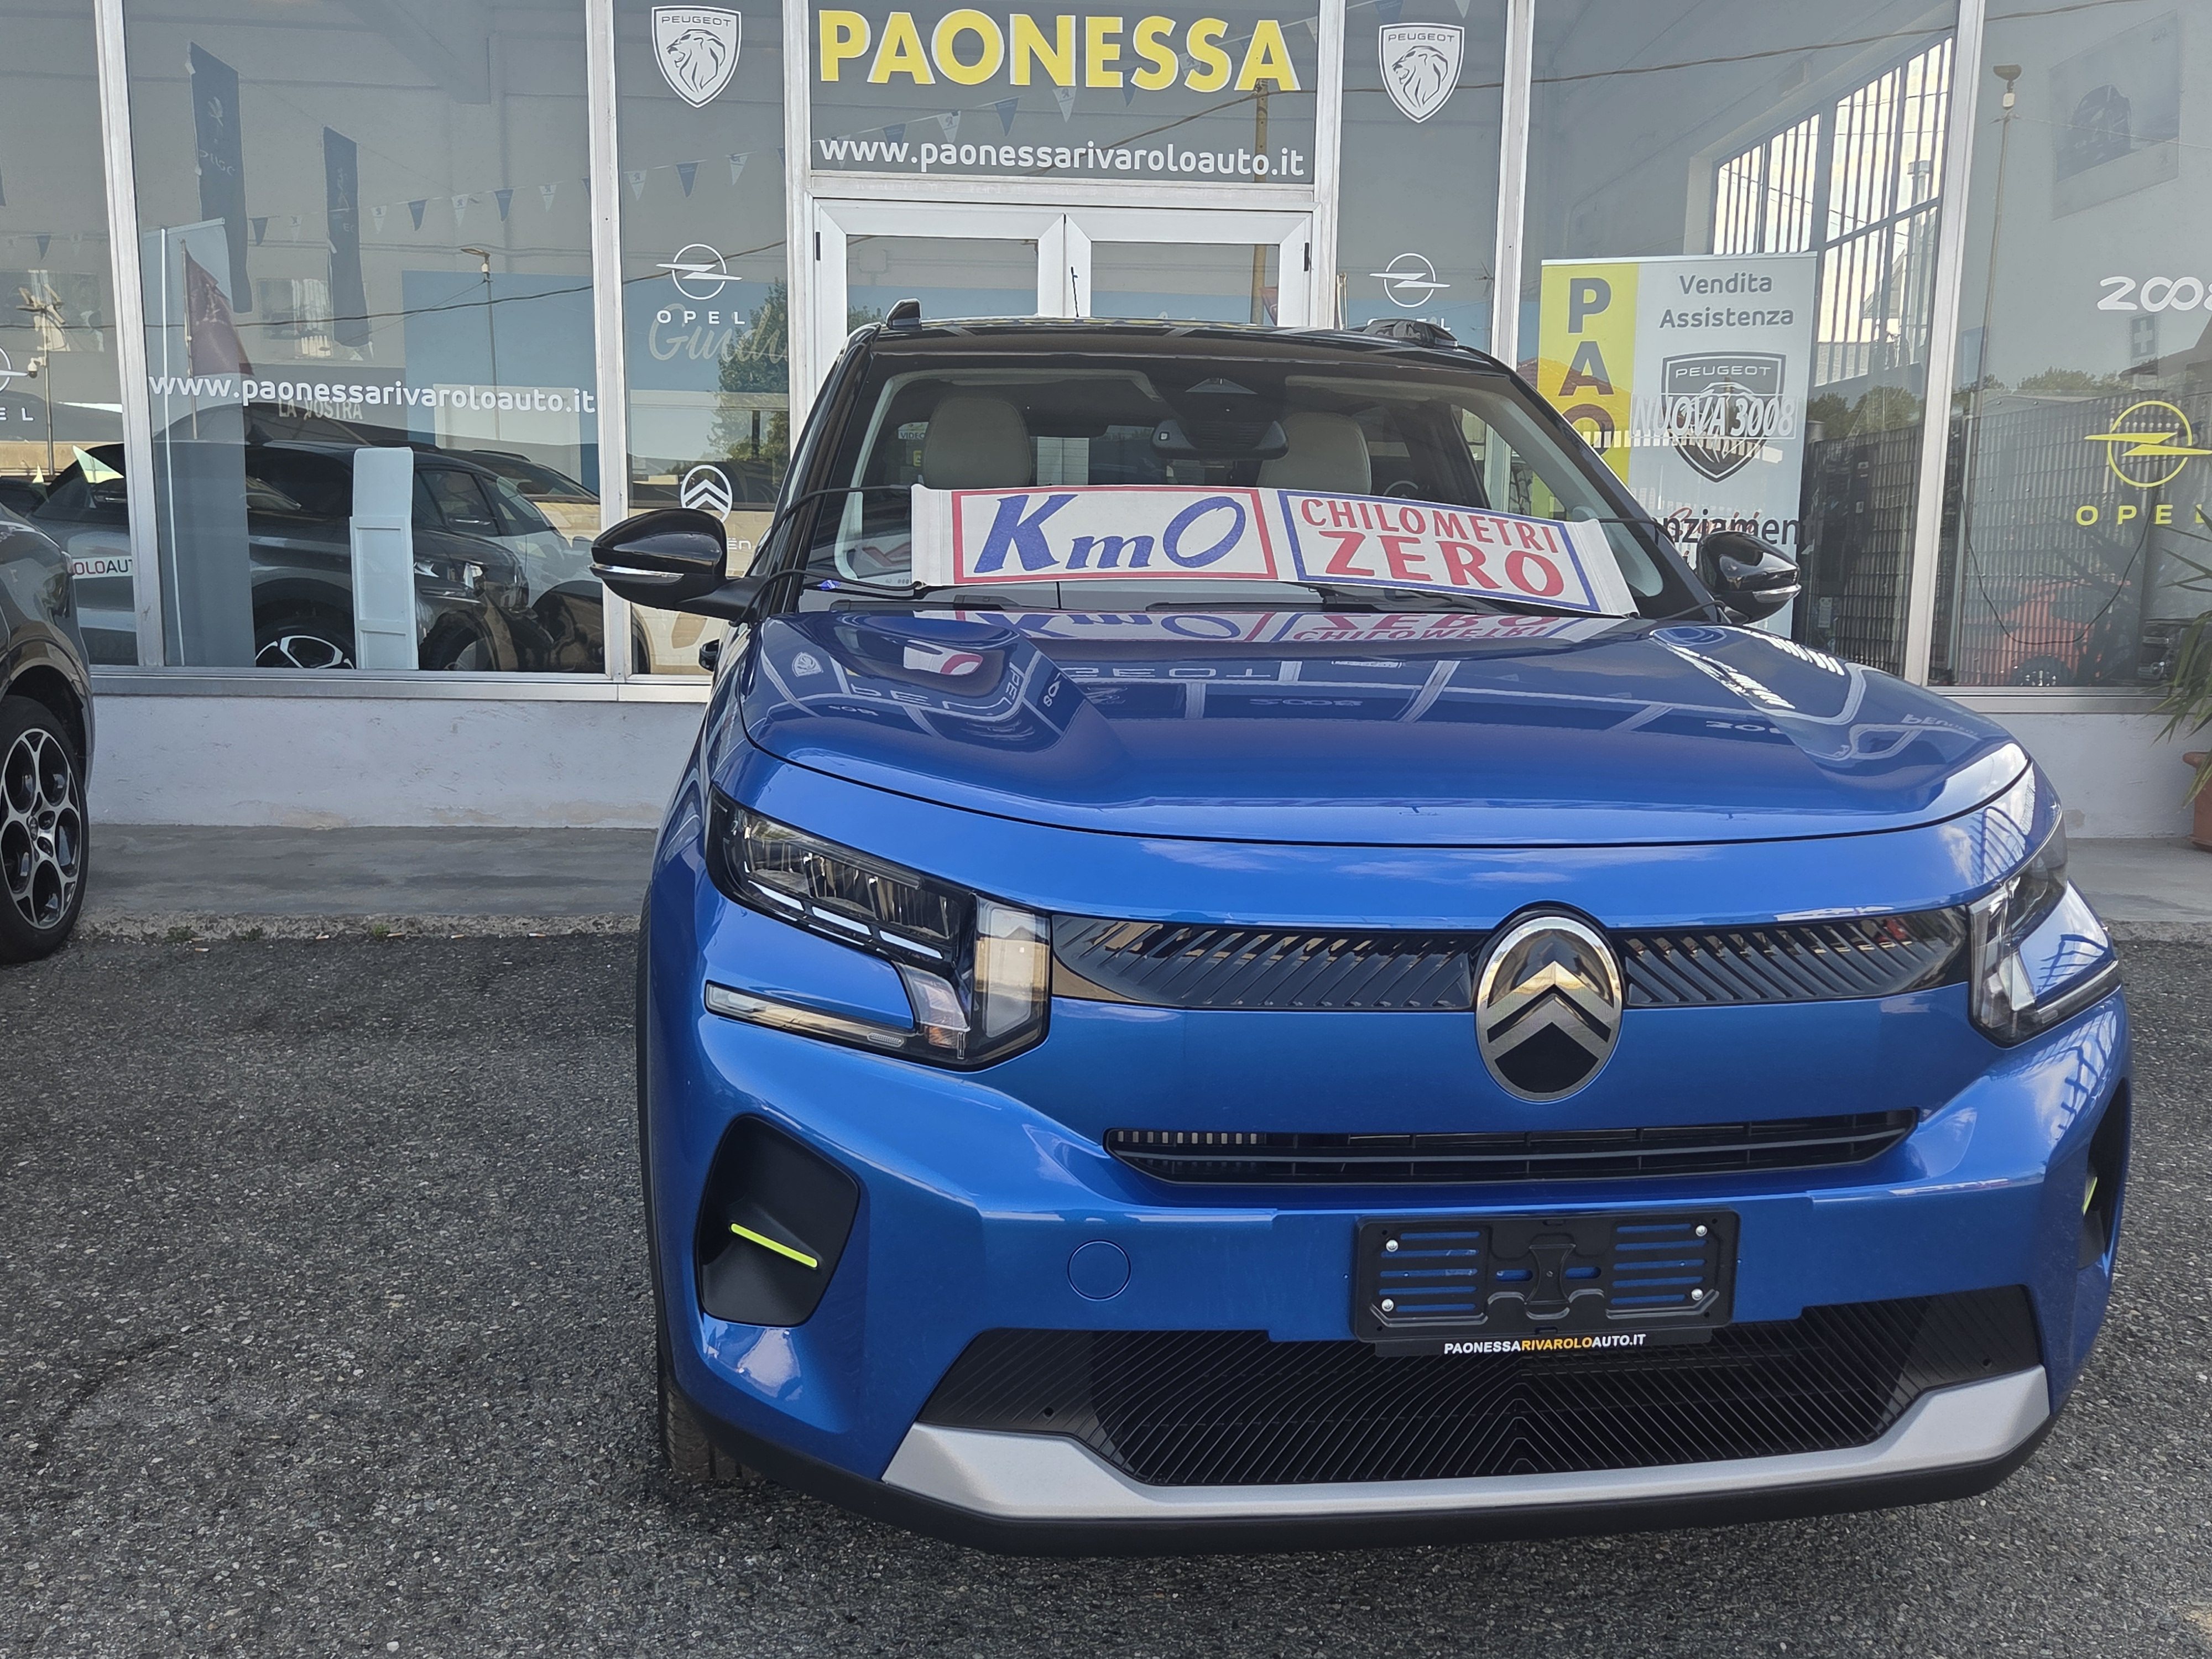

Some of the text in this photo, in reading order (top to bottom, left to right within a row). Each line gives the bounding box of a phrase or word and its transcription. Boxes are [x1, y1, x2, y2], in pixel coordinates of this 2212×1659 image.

[661, 15, 732, 27] PEUGEOT
[820, 9, 1301, 92] PAONESSA
[1387, 32, 1455, 43] PEUGEOT
[818, 139, 1305, 176] www.paonessarivaroloauto.it
[1679, 273, 1773, 295] Vendita
[2097, 276, 2212, 312] 200
[656, 310, 745, 325] OPEL
[1659, 307, 1794, 328] Assistenza
[1674, 364, 1772, 378] PEUGEOT
[148, 375, 597, 414] www.paonessarivaroloauto.it
[1632, 395, 1795, 437] NUOVA 3008
[1301, 498, 1559, 554] CHILOMETRI
[1318, 530, 1564, 597] ZERO
[1443, 1333, 1646, 1355] PAONESSARIVAROLOAUTO.IT
